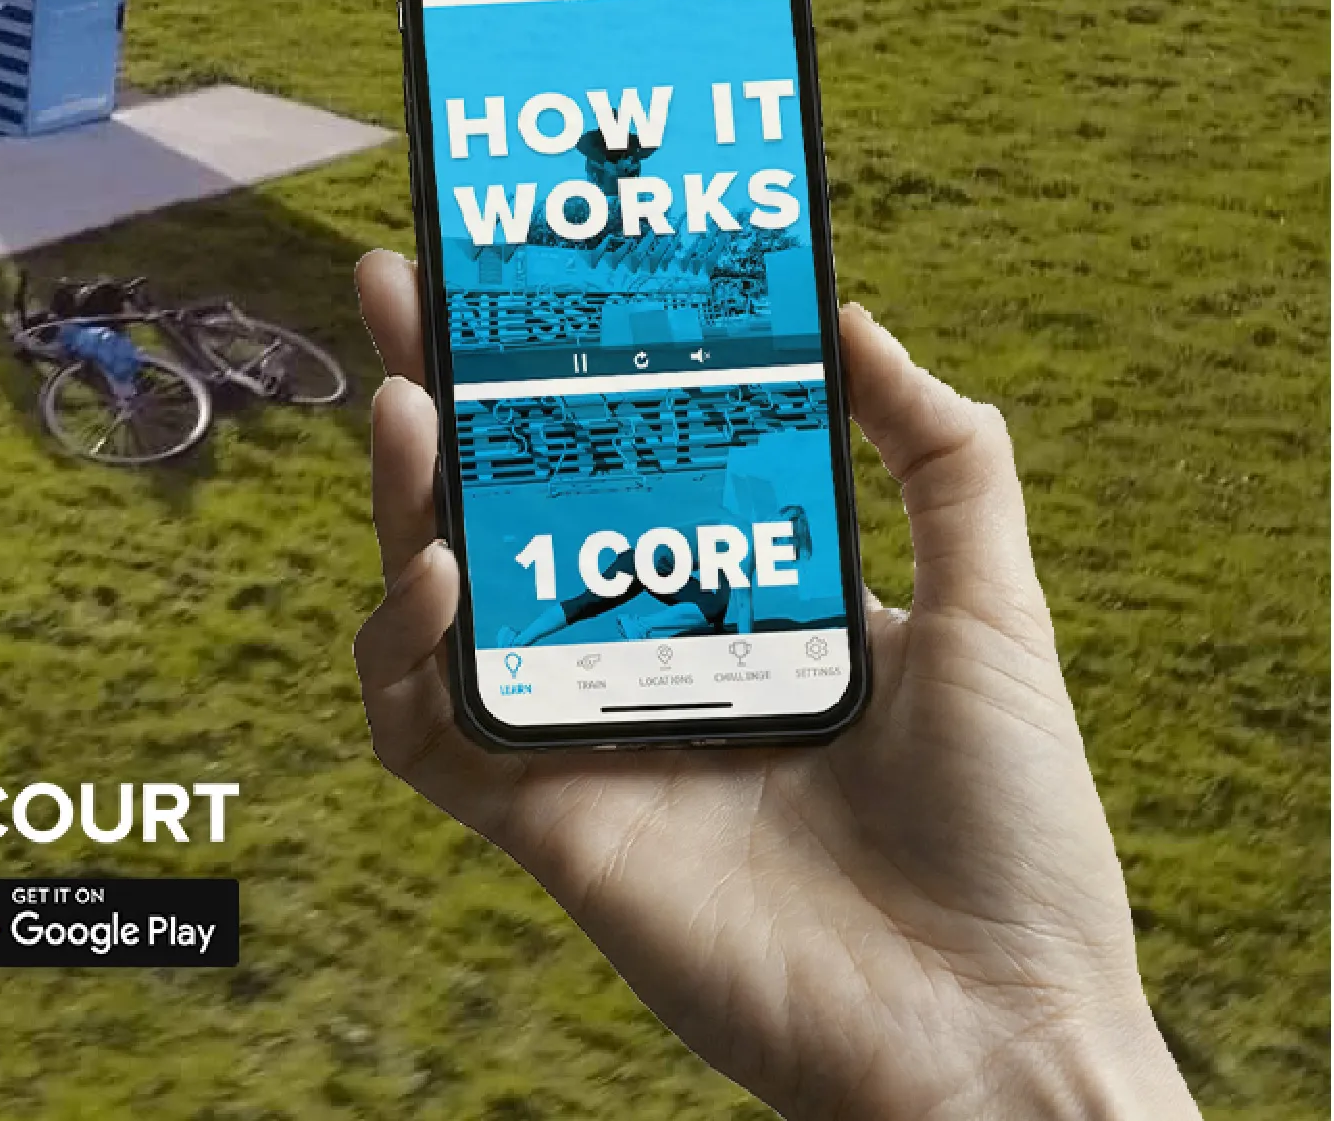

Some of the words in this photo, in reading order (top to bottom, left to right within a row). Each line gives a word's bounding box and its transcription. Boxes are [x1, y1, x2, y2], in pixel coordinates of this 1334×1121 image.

[445, 86, 674, 159] HOW
[712, 80, 796, 145] IT
[453, 168, 801, 247] WORKS
[515, 534, 557, 601] 1
[578, 521, 799, 599] CORE
